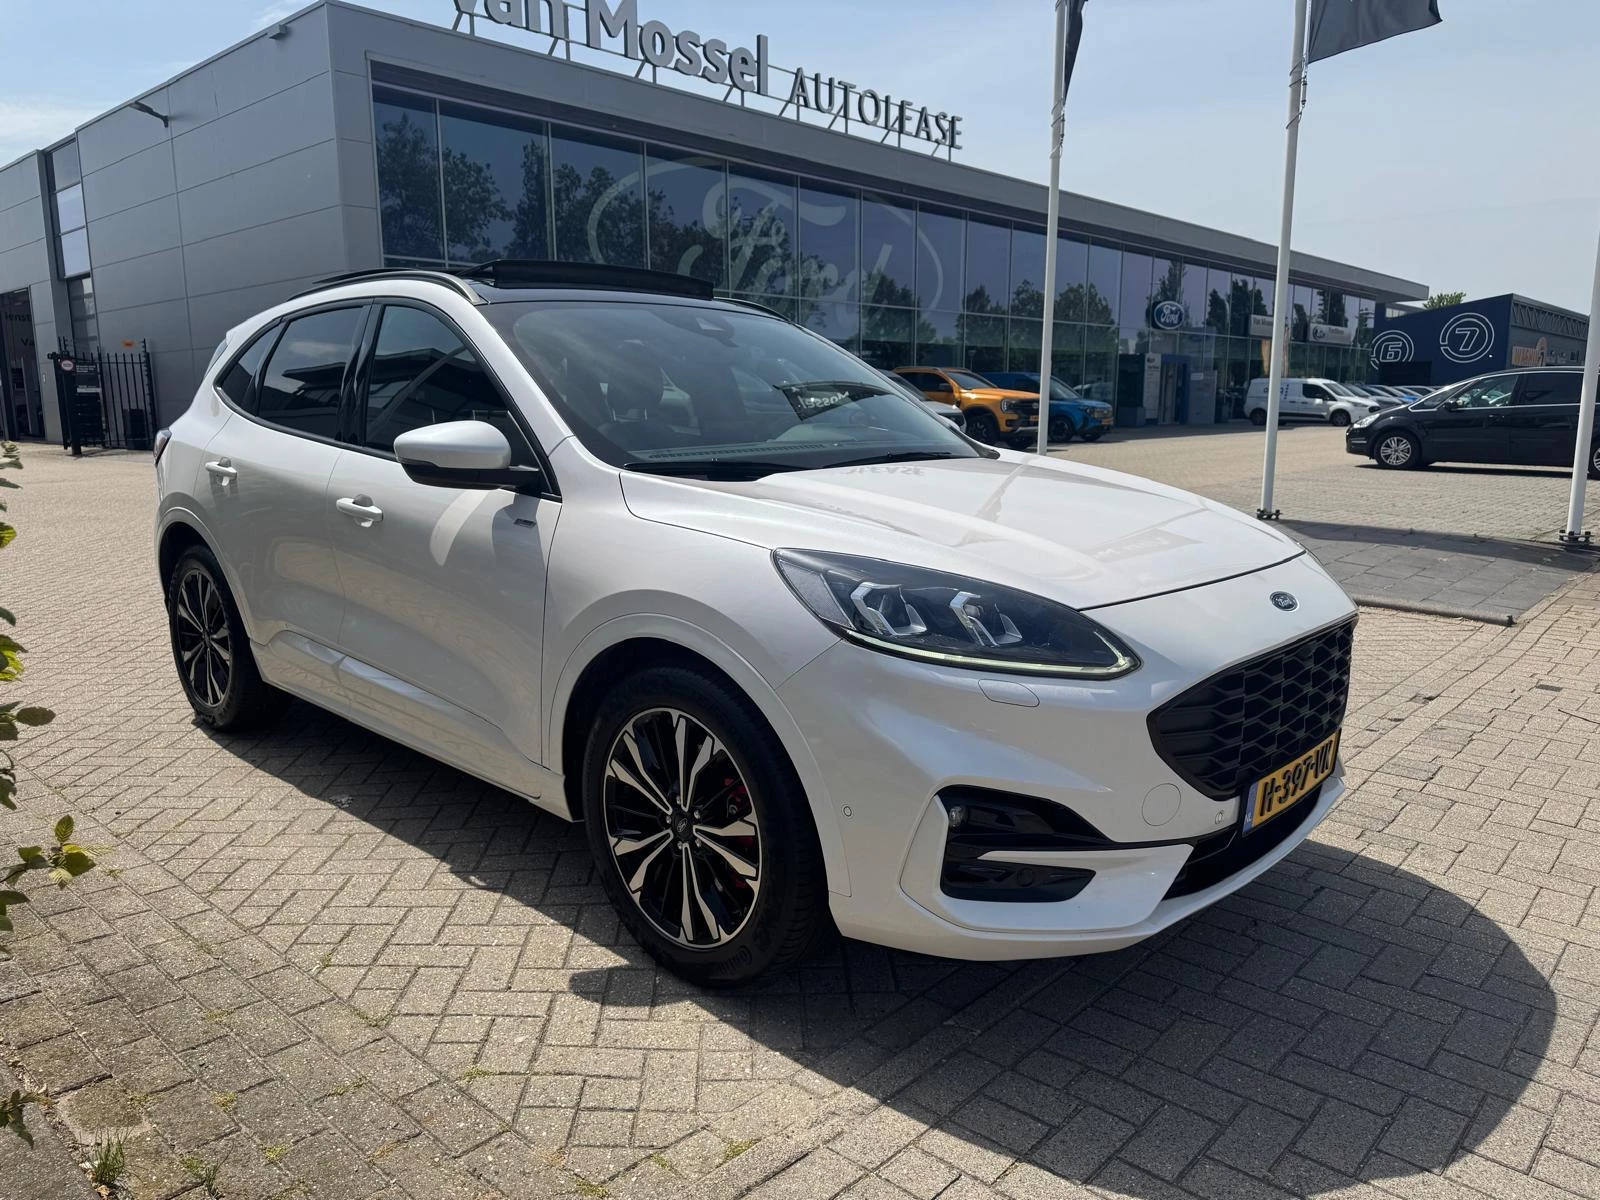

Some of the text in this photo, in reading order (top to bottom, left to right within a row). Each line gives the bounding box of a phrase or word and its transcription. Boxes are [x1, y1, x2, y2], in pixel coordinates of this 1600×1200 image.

[585, 0, 768, 95] Mossel
[789, 66, 963, 150] AUTOLEASE
[1455, 327, 1479, 351] 7
[1380, 341, 1402, 362] 6
